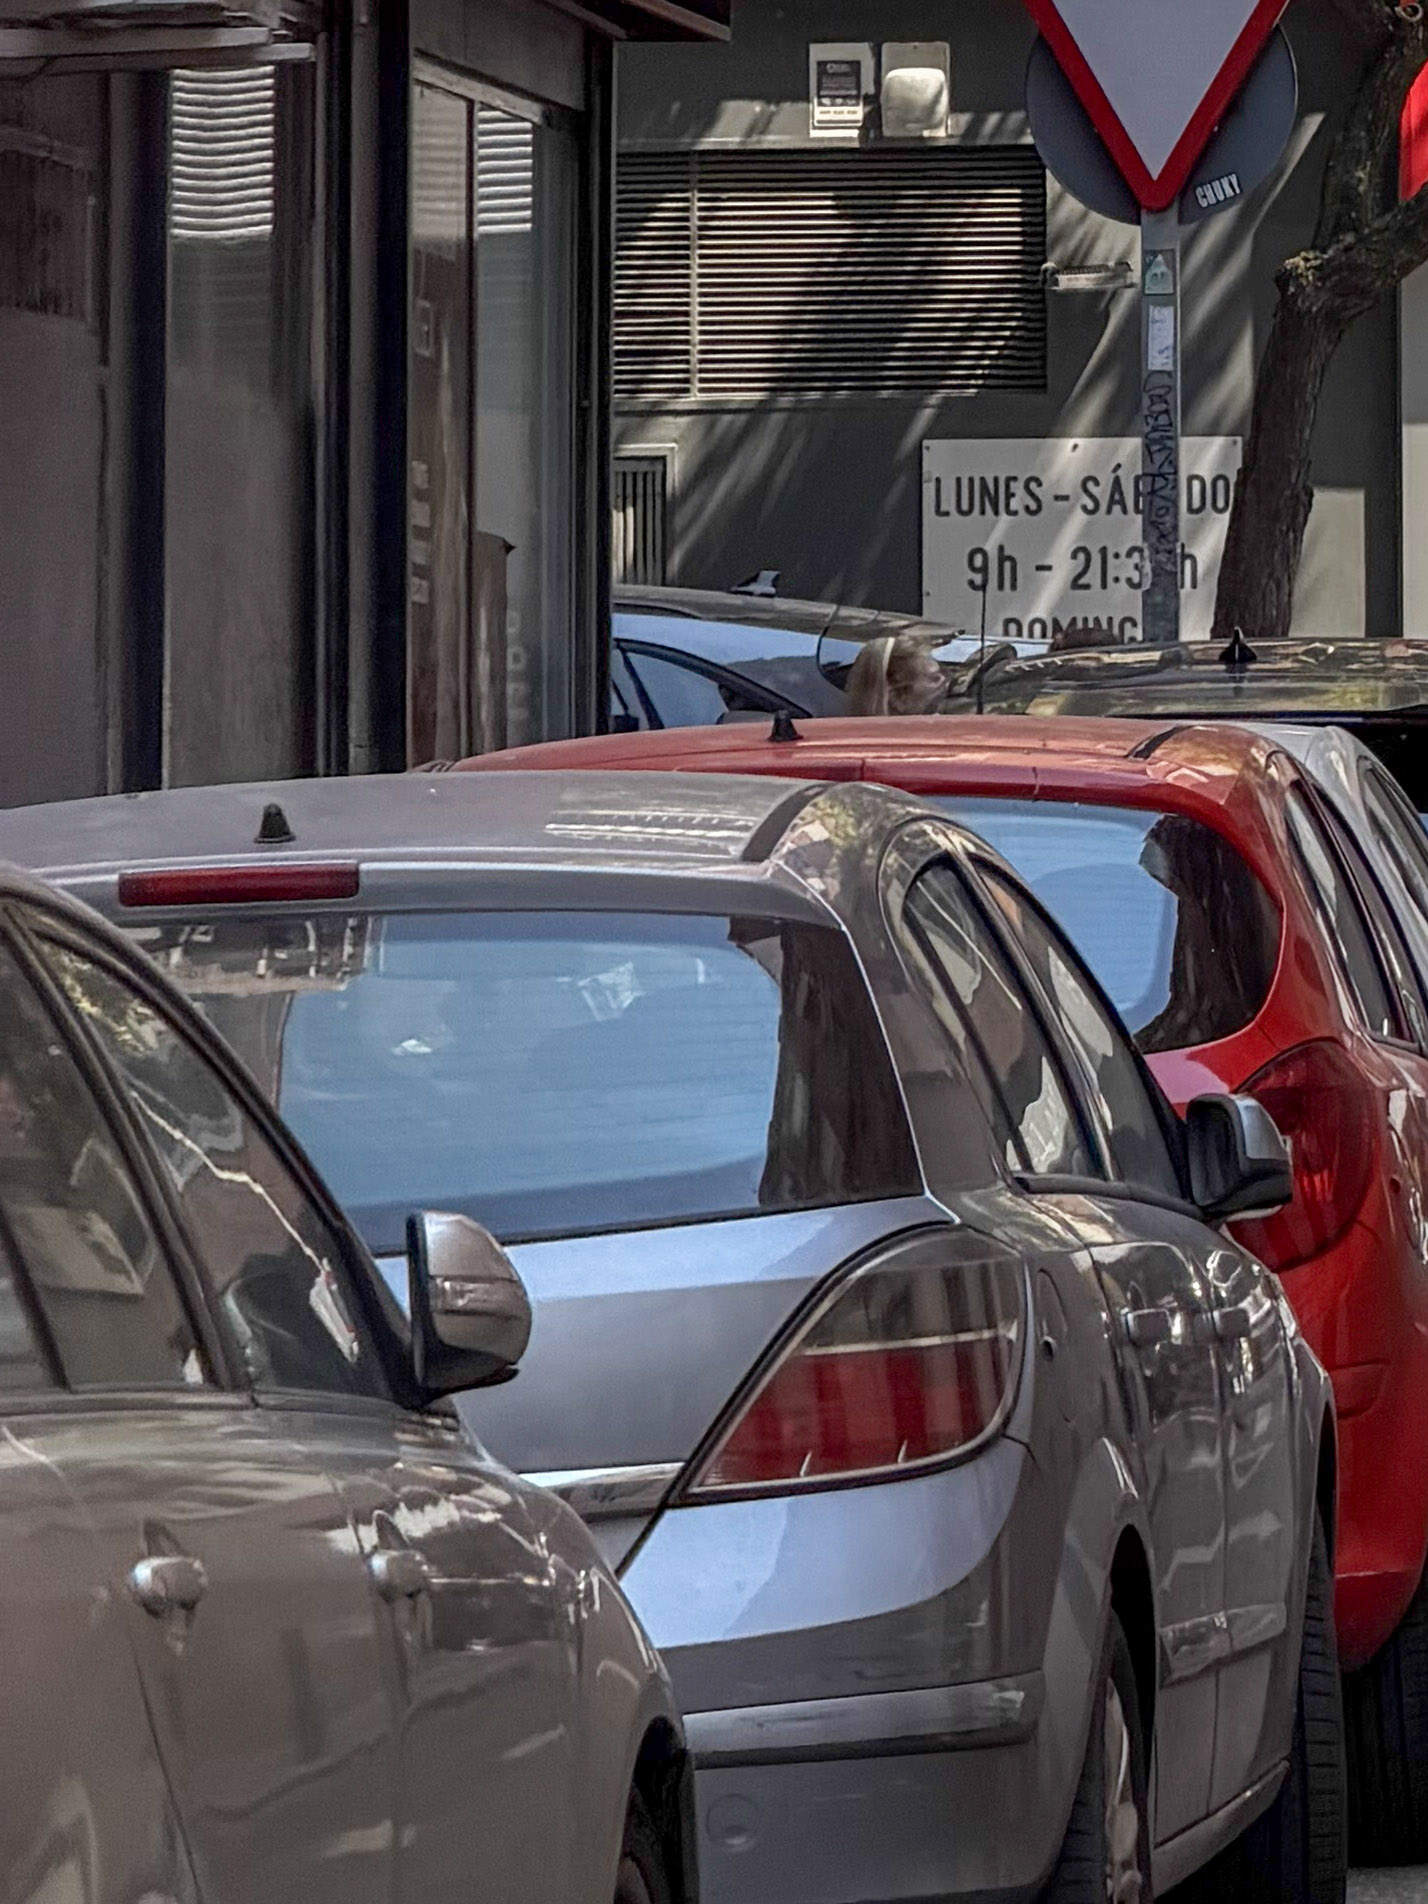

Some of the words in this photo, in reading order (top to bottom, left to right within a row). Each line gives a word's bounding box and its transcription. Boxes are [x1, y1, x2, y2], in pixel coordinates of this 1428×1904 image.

[1195, 173, 1241, 208] CHUKY
[934, 475, 1044, 518] LUNES
[1080, 462, 1231, 516] SÁDO
[966, 544, 1018, 592] 9h
[1070, 542, 1198, 591] 21:3h
